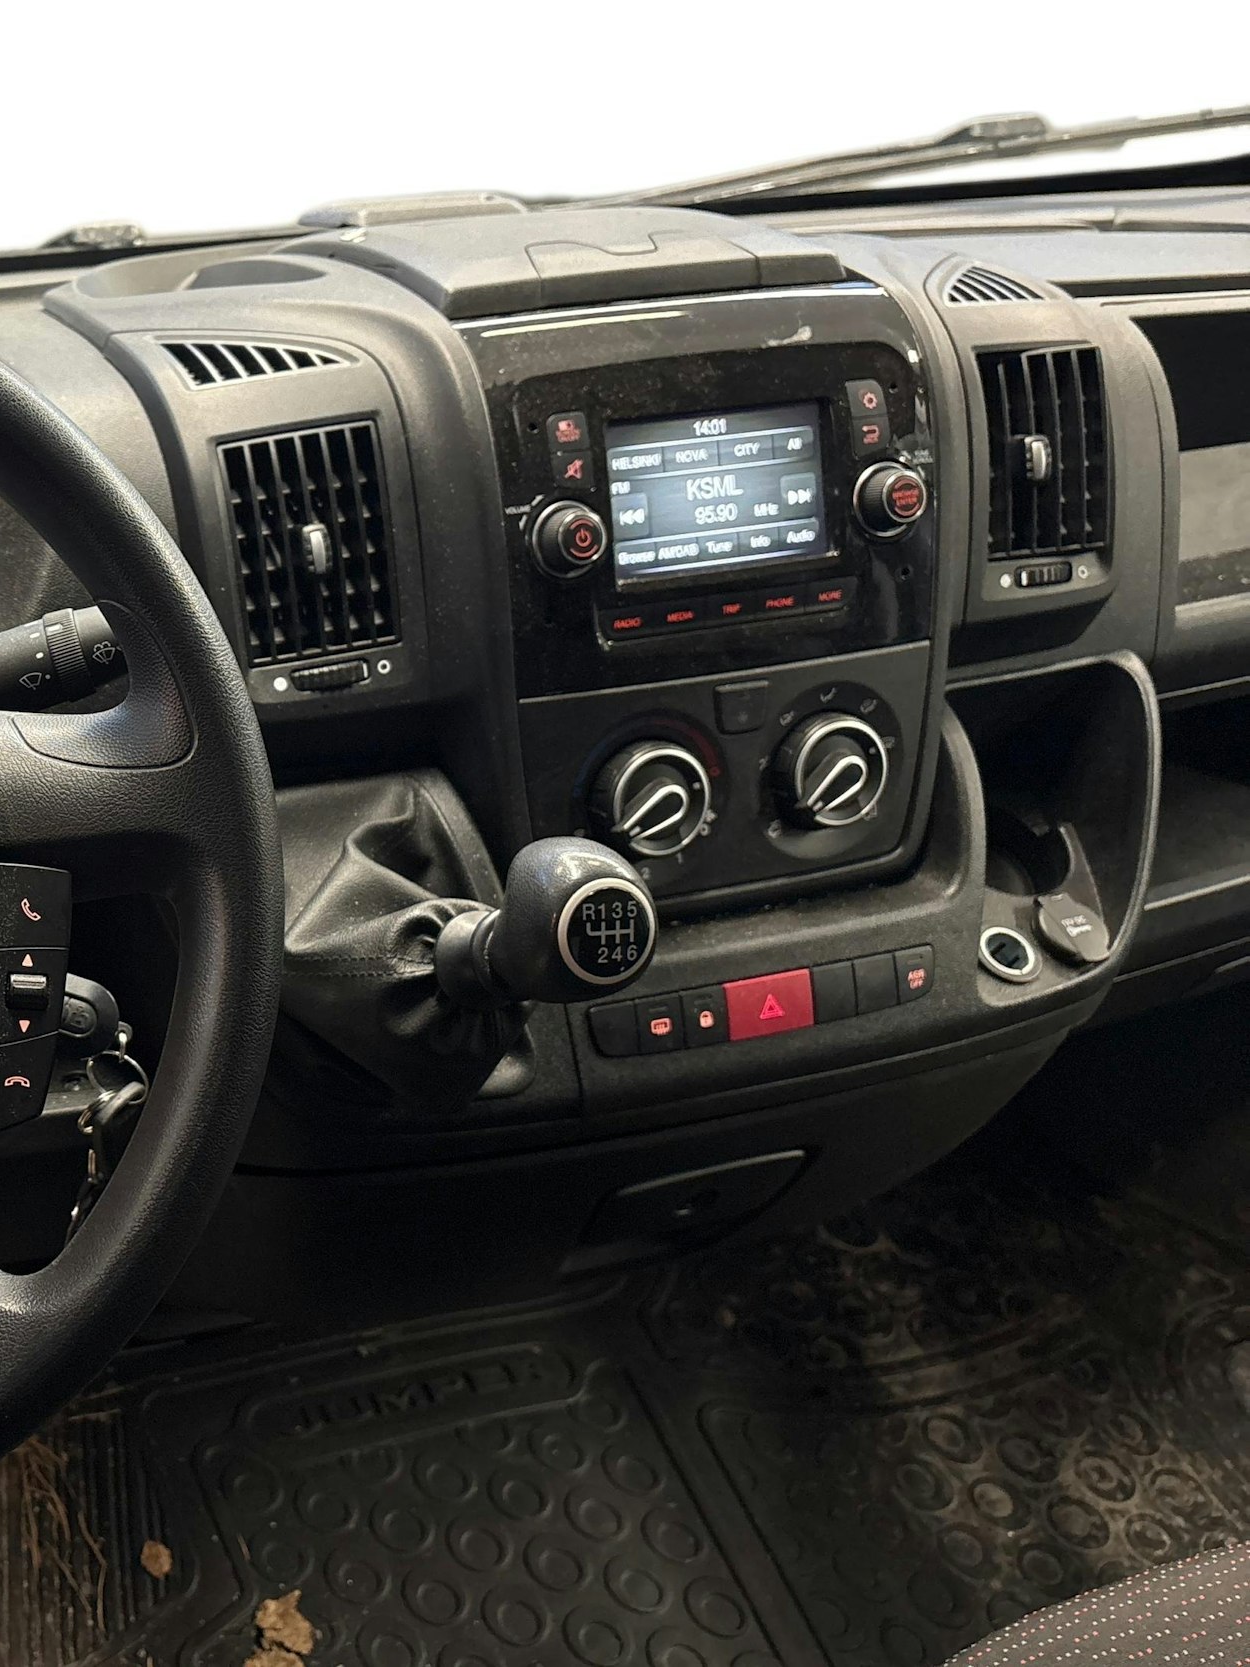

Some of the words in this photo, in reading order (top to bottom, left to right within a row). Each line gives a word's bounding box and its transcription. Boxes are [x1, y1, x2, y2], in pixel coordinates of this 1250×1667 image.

[693, 418, 727, 435] 14:01
[611, 453, 662, 471] HELSINKI
[675, 448, 709, 464] NOVA
[733, 442, 760, 457] CITY
[611, 481, 631, 495] FM
[686, 474, 744, 501] KSML
[505, 503, 532, 515] VOLUME
[694, 502, 738, 525] 95.90
[754, 502, 779, 518] MHz
[618, 549, 655, 566] Browse
[706, 539, 733, 554] Tune
[750, 535, 771, 548] Info
[786, 529, 816, 544] Audio
[818, 588, 843, 602] MORE
[722, 603, 742, 616] TRIP
[766, 596, 795, 609] PHONE
[613, 616, 643, 630] RADIO
[666, 610, 695, 623] MEDIA
